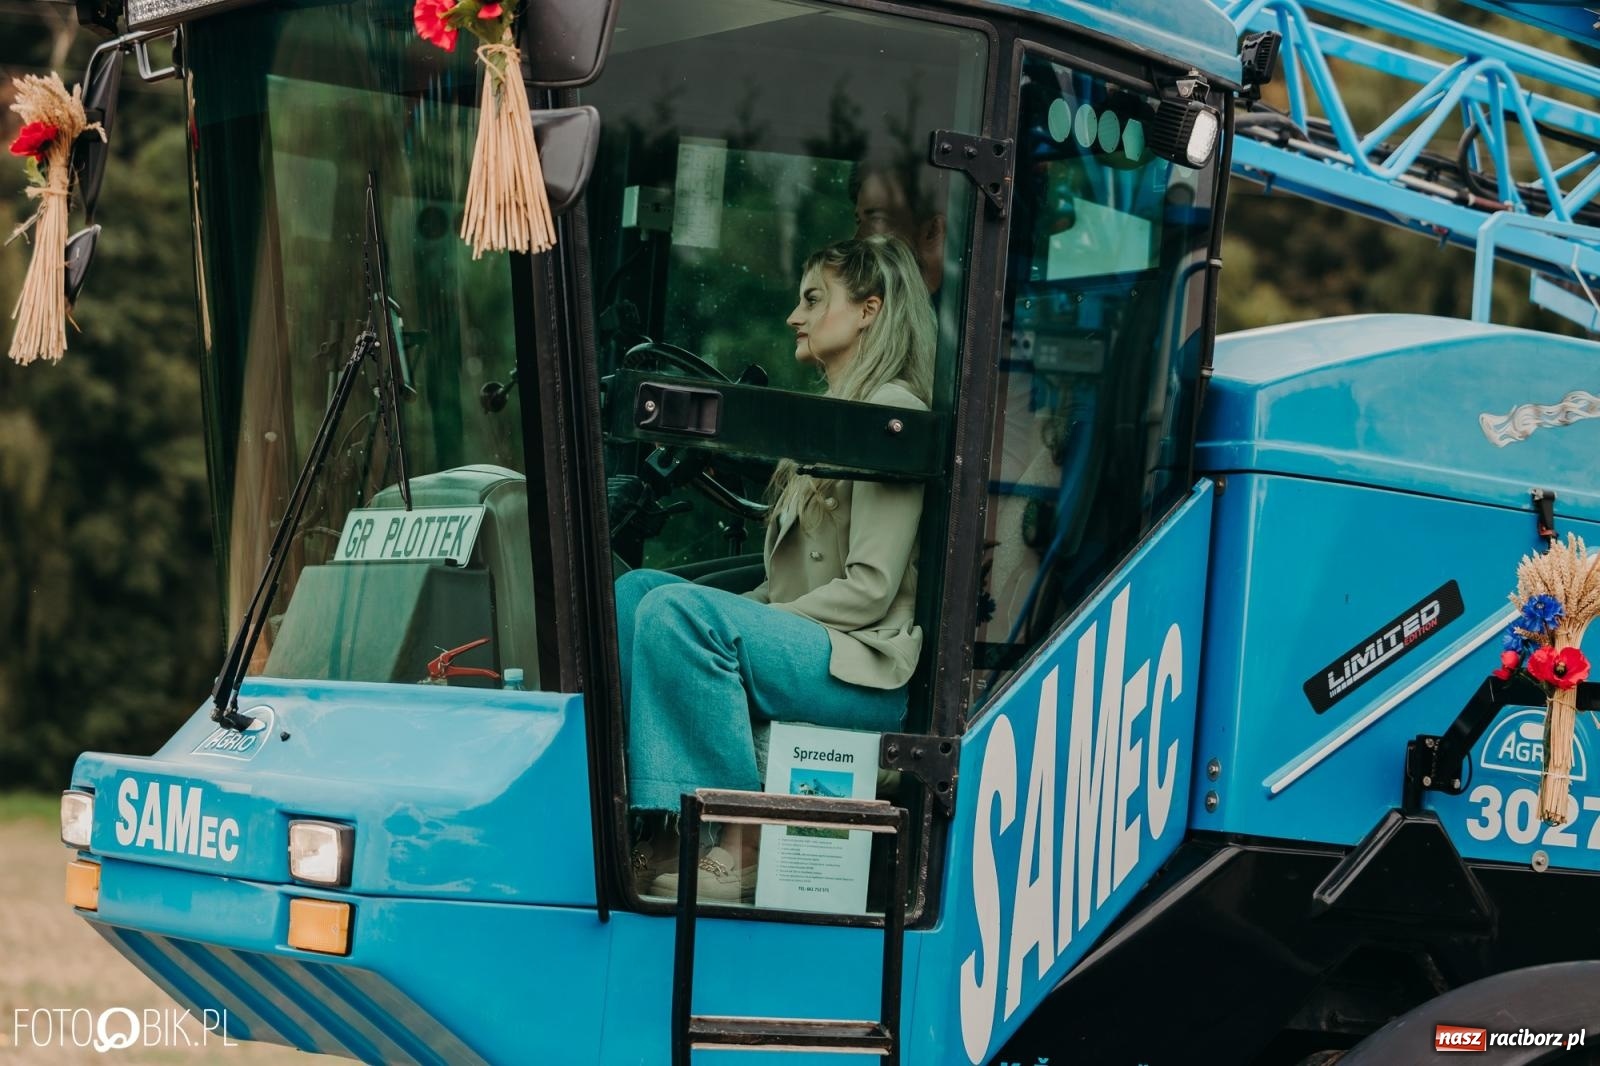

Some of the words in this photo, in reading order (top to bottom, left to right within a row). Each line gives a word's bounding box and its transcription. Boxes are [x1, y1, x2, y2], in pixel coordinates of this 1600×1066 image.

[345, 518, 374, 558] GR
[380, 515, 472, 558] PLOTTEK
[1328, 600, 1440, 690] LIMITED
[1403, 617, 1438, 646] EDITION
[793, 746, 854, 763] Sprzedam
[115, 777, 239, 862] SAMEC
[960, 582, 1182, 1065] SAMEC
